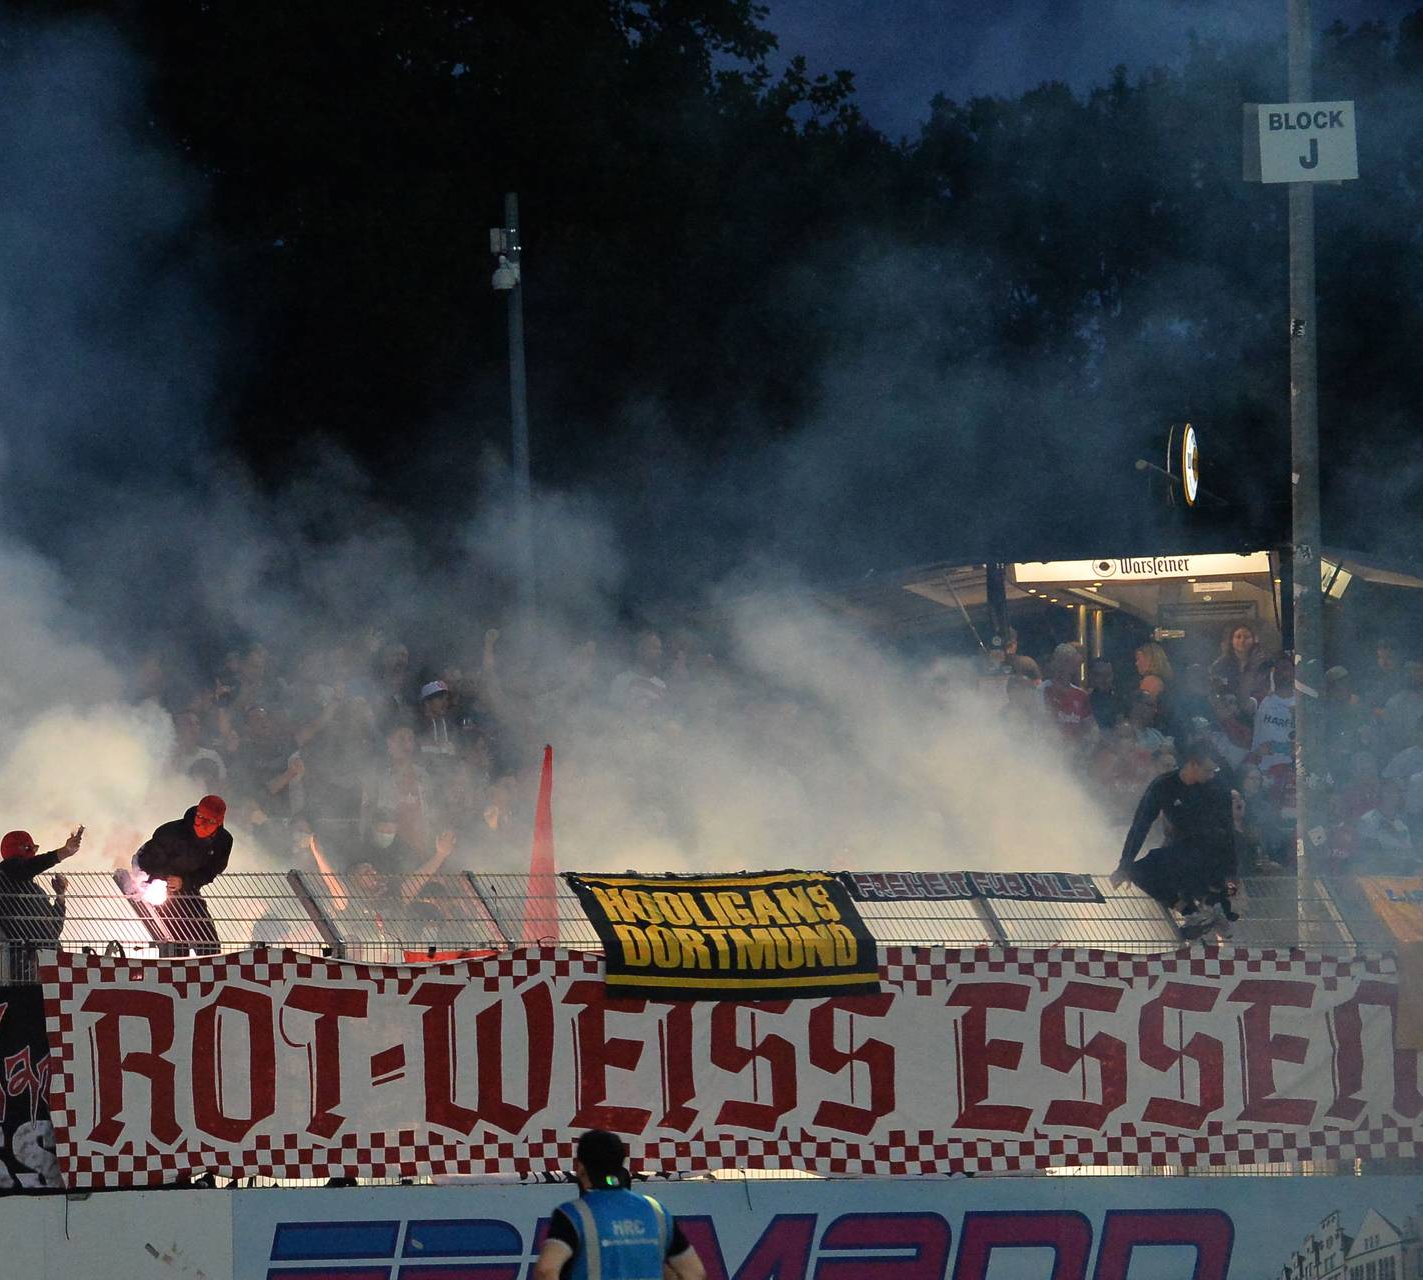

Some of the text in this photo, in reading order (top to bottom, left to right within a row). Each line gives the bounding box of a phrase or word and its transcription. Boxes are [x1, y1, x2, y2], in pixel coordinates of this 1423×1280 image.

[1269, 111, 1344, 131] BLOCK
[1299, 138, 1319, 169] J
[851, 872, 971, 897] FREIHEIT
[592, 884, 841, 926] HOOLIGANS
[614, 923, 857, 970] DORTMUND
[77, 980, 896, 1146] ROT-WEISS
